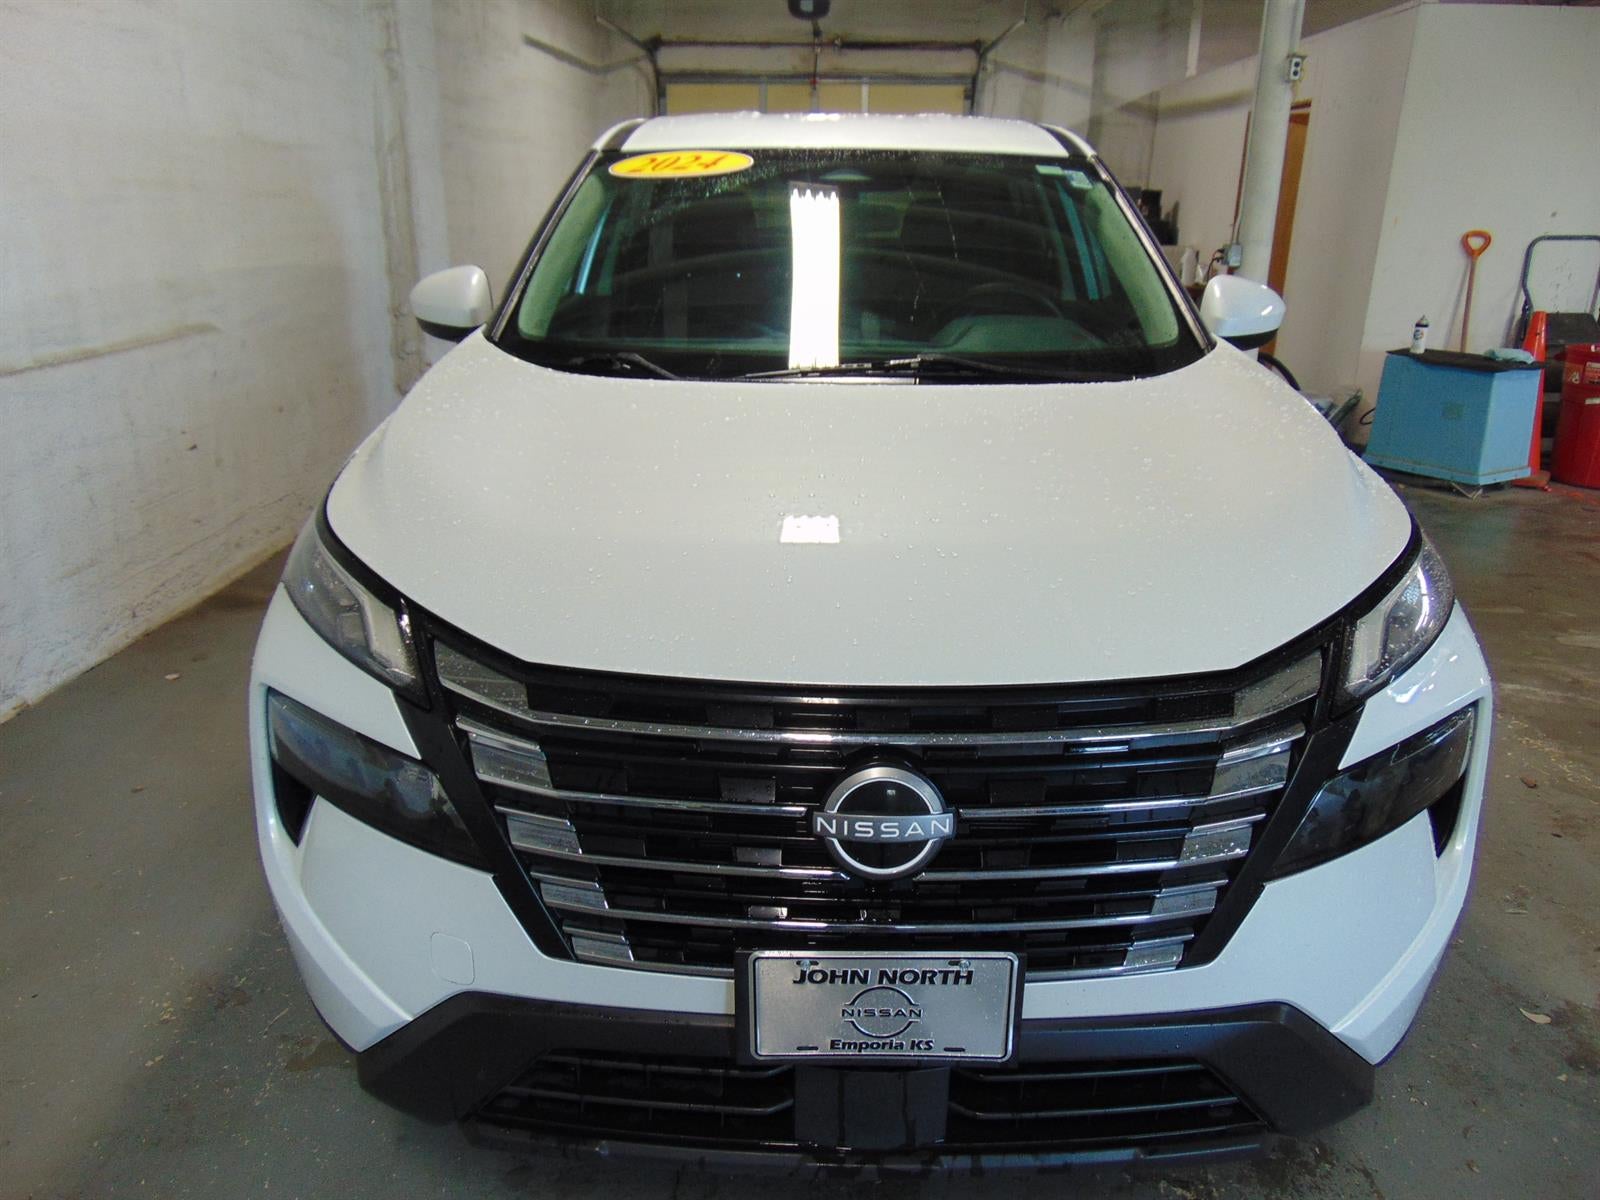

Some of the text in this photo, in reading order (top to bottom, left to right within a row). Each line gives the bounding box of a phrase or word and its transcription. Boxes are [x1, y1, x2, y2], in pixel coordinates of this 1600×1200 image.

[626, 154, 728, 172] 2024
[816, 816, 950, 838] NISSAN
[793, 968, 973, 985] JOHN NORTH
[841, 1008, 922, 1018] NISSAN
[830, 1039, 934, 1053] Emporia KS
